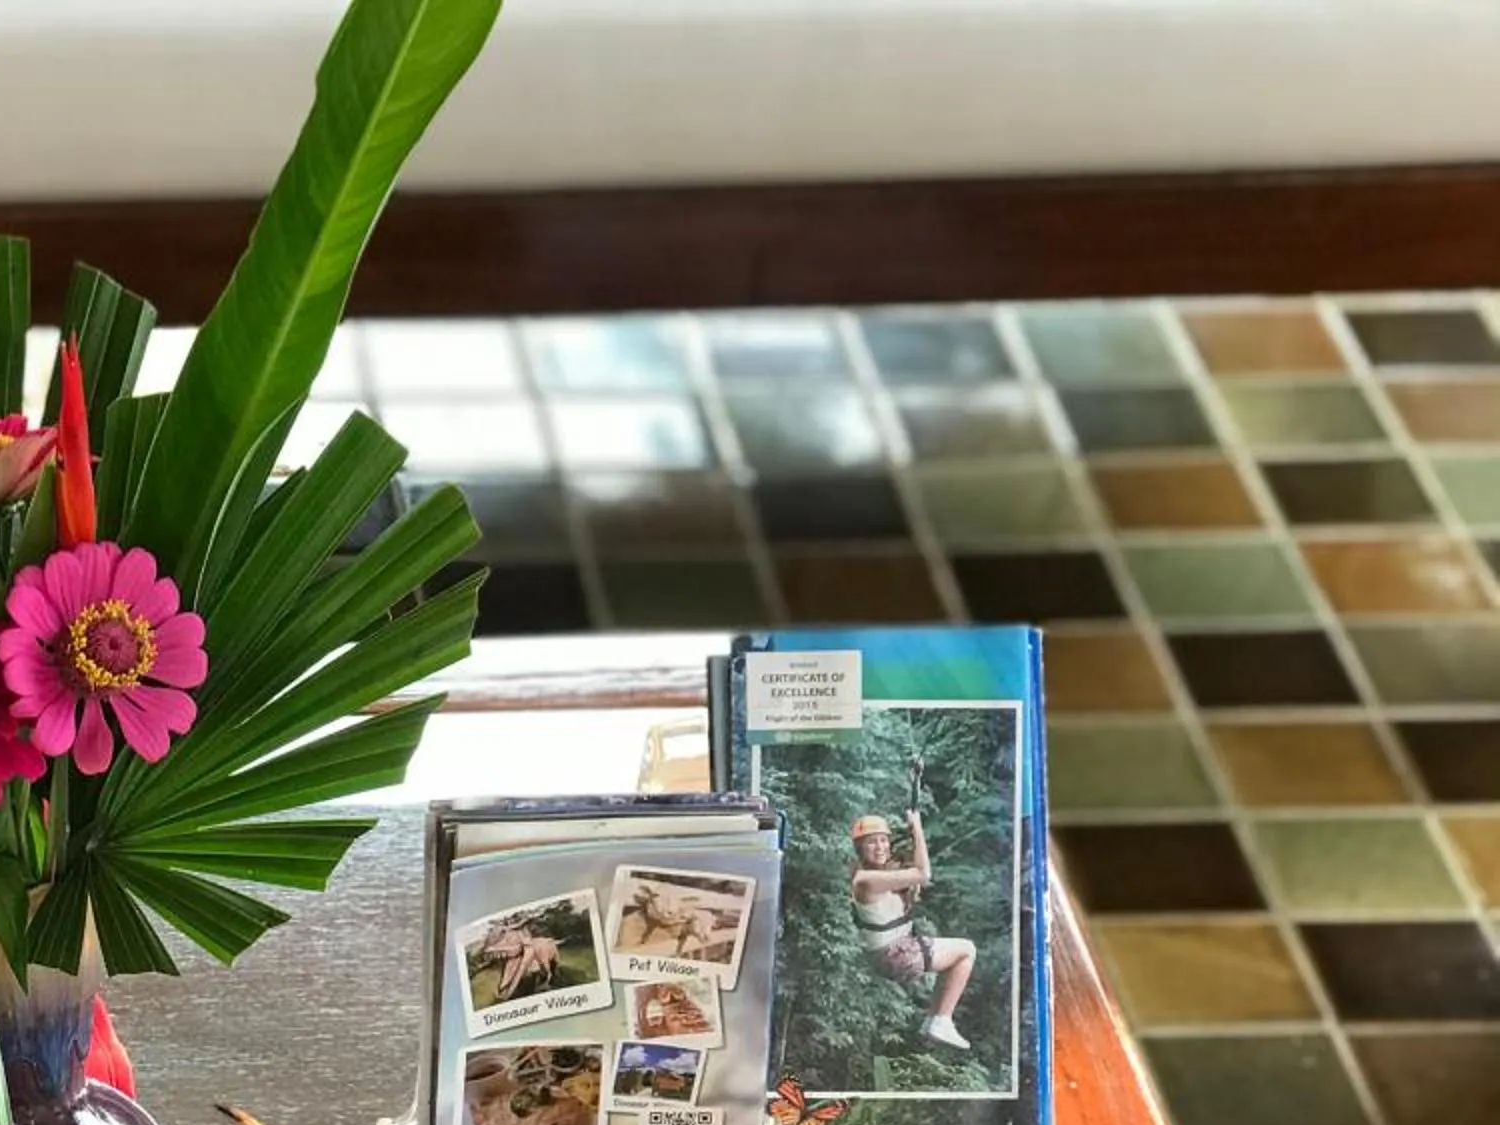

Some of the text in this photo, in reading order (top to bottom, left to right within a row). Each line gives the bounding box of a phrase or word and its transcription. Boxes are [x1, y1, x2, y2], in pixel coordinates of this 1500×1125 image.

[761, 672, 845, 683] CERTIFICATE OF
[771, 687, 837, 697] EXCELLENCE
[629, 957, 651, 971] Pet
[483, 993, 589, 1025] Dinosaur Village
